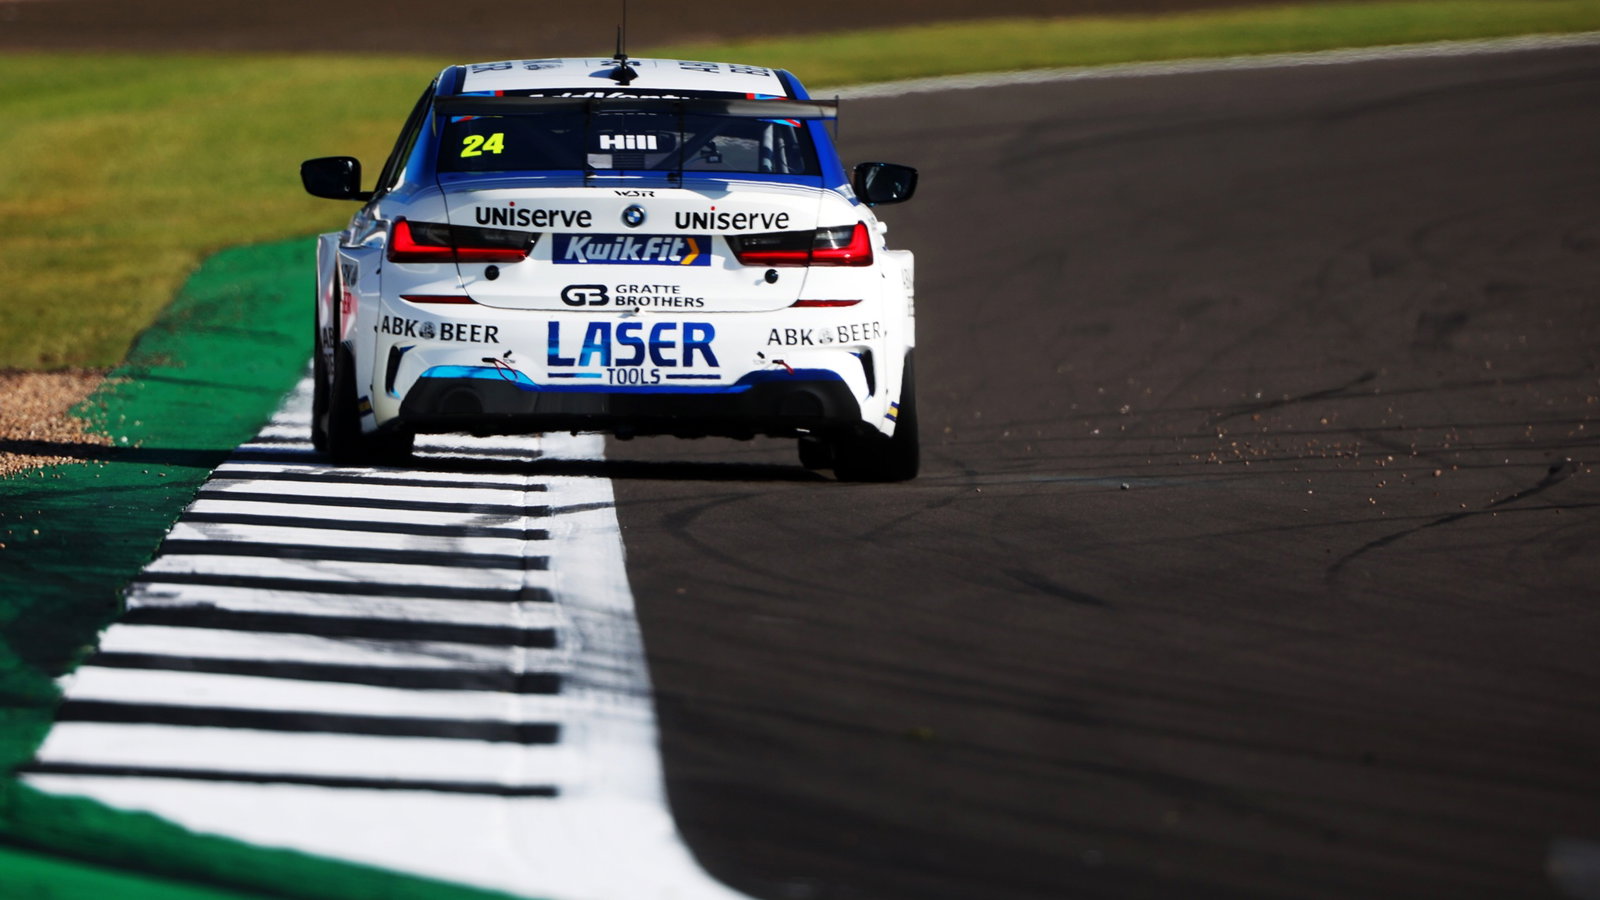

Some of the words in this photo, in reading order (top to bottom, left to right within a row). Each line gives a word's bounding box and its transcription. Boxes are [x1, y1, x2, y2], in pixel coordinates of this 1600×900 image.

[460, 133, 505, 158] 24
[599, 135, 658, 150] Hill
[560, 284, 610, 307] GB
[615, 284, 681, 295] GRATTE
[615, 296, 705, 308] BROTHERS
[381, 315, 419, 338] ABK
[440, 322, 500, 344] BEER
[767, 328, 815, 346] ABK
[837, 321, 880, 344] BEER
[547, 321, 720, 367] LASER
[607, 368, 661, 385] TOOLS
